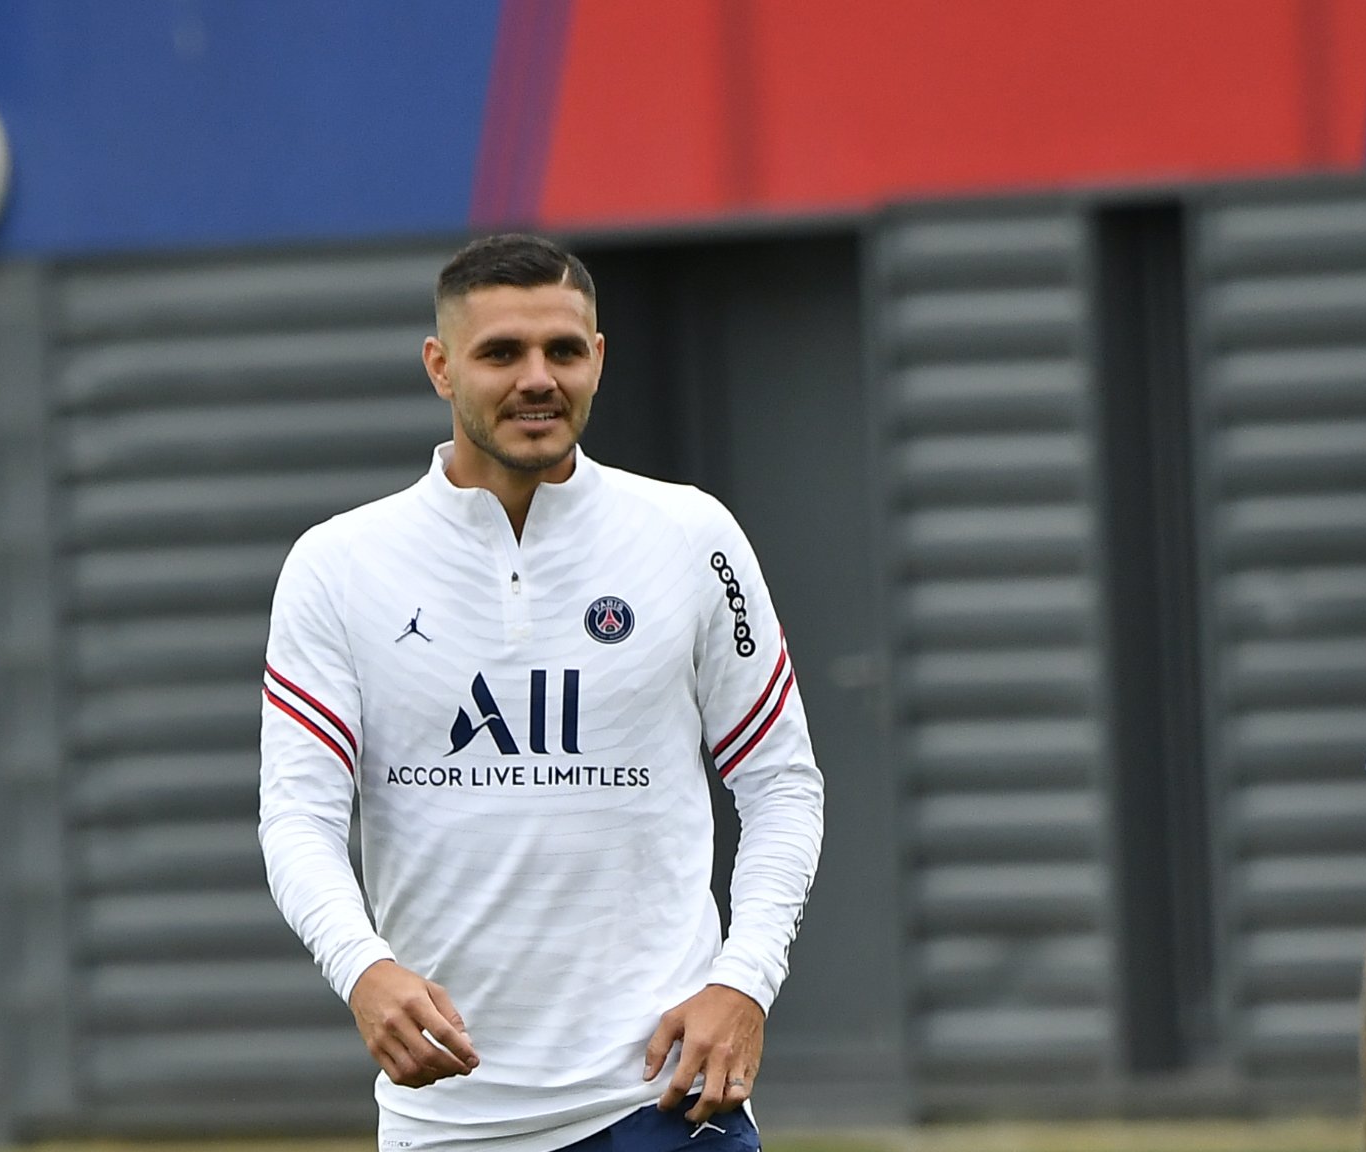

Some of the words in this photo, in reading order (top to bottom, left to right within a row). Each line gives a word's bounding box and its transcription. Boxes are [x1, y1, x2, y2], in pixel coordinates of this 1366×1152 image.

[593, 599, 625, 612] PARIS
[710, 551, 756, 658] ooredoo
[387, 766, 462, 786] ACCOR
[472, 766, 525, 786] LIVE
[534, 766, 650, 787] LIMITLESS
